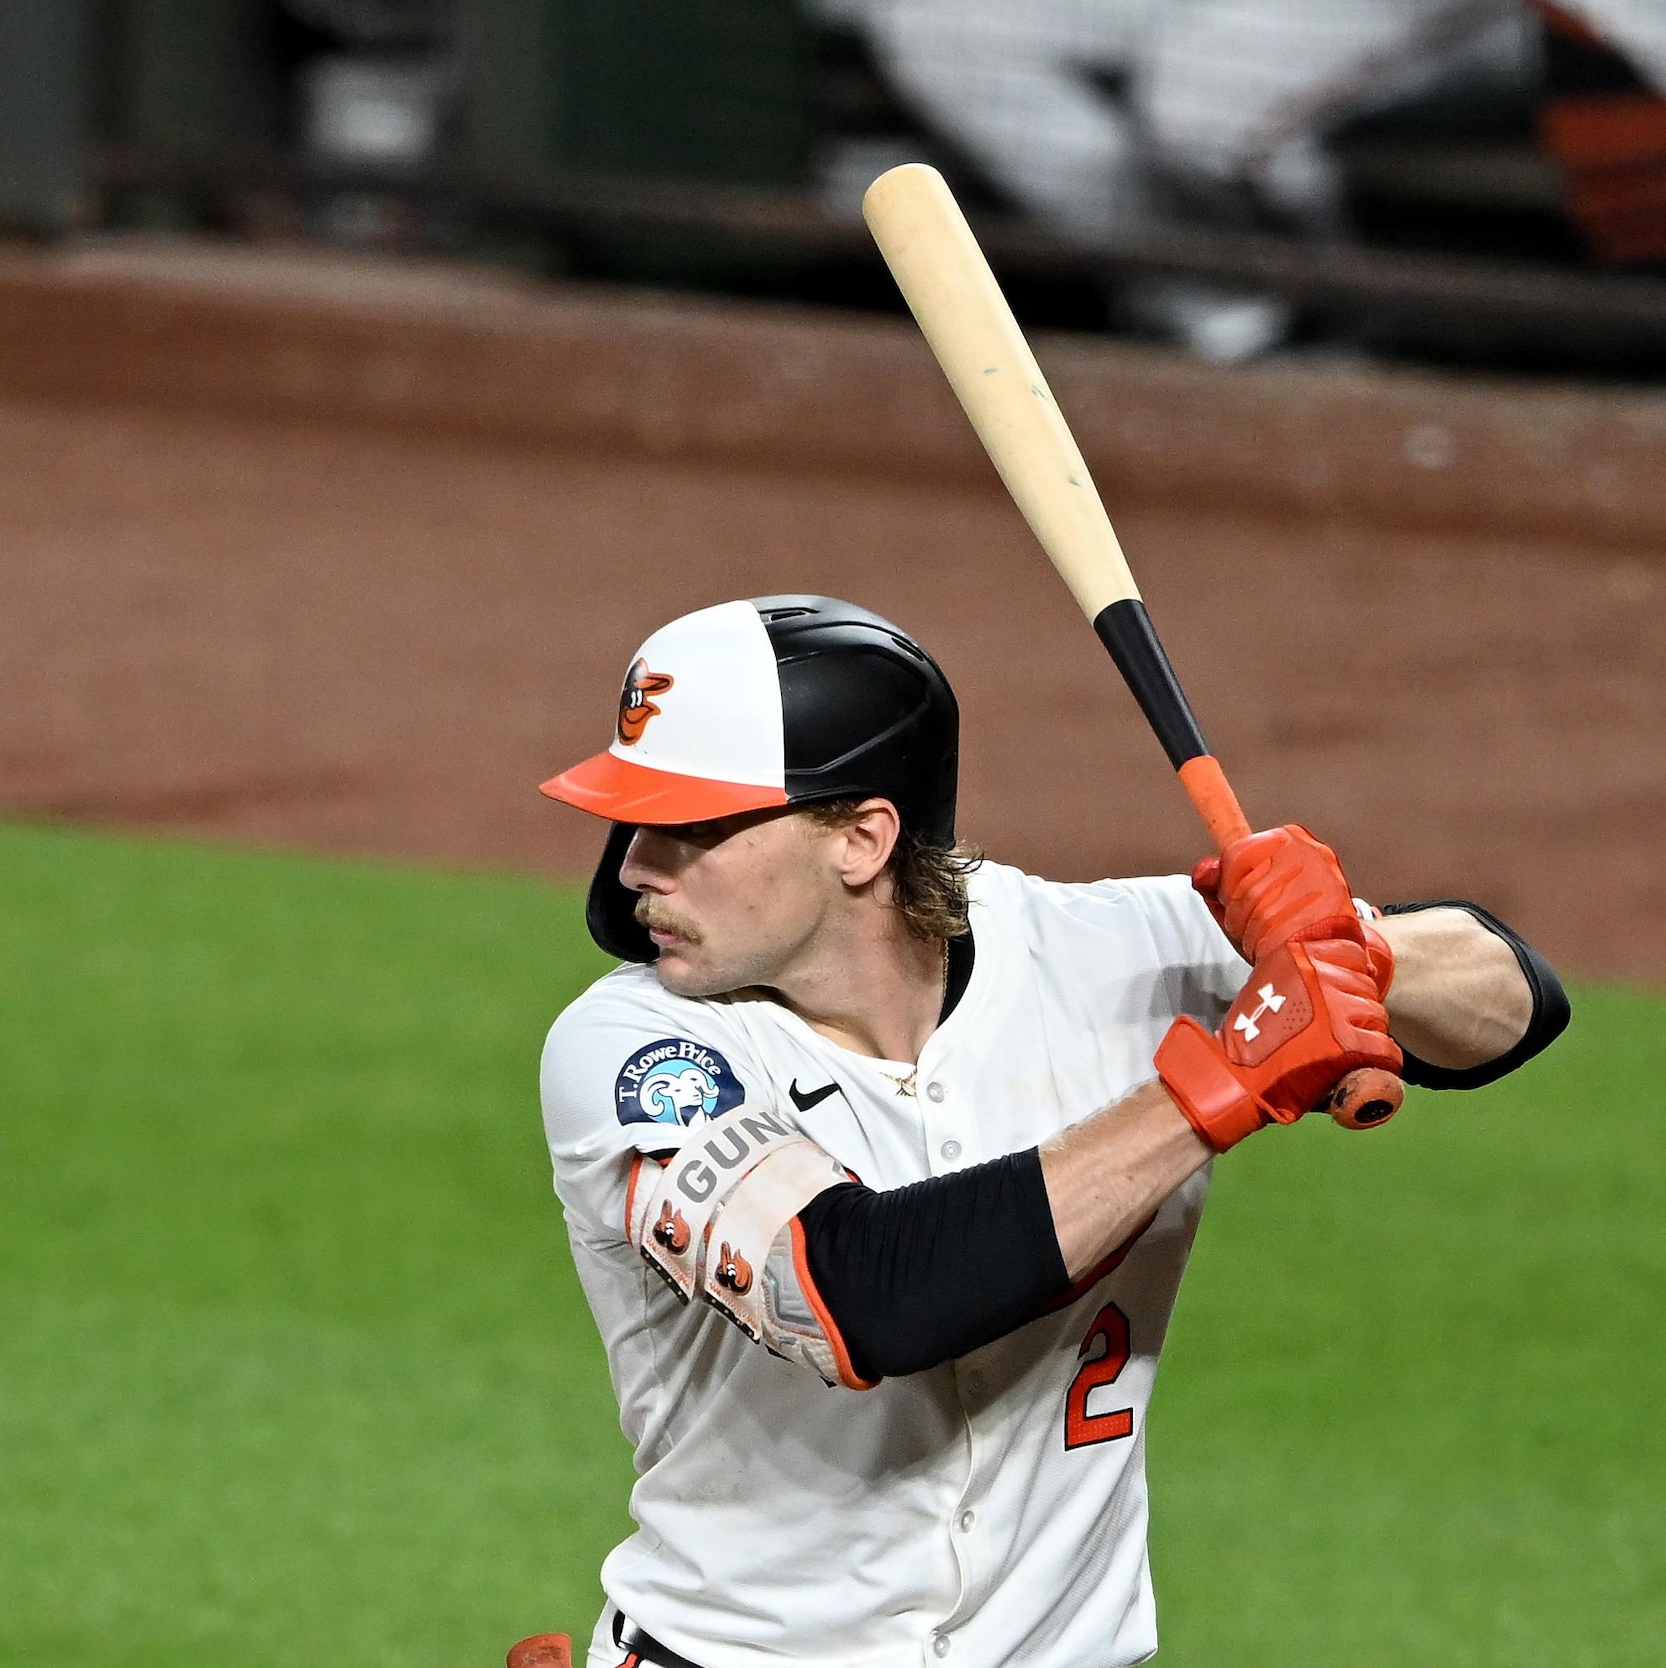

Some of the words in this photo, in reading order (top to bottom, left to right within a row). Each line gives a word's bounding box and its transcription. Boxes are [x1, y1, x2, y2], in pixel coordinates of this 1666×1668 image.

[677, 1041, 722, 1076] Price
[676, 1111, 796, 1204] GUN
[1064, 1301, 1134, 1452] 2
